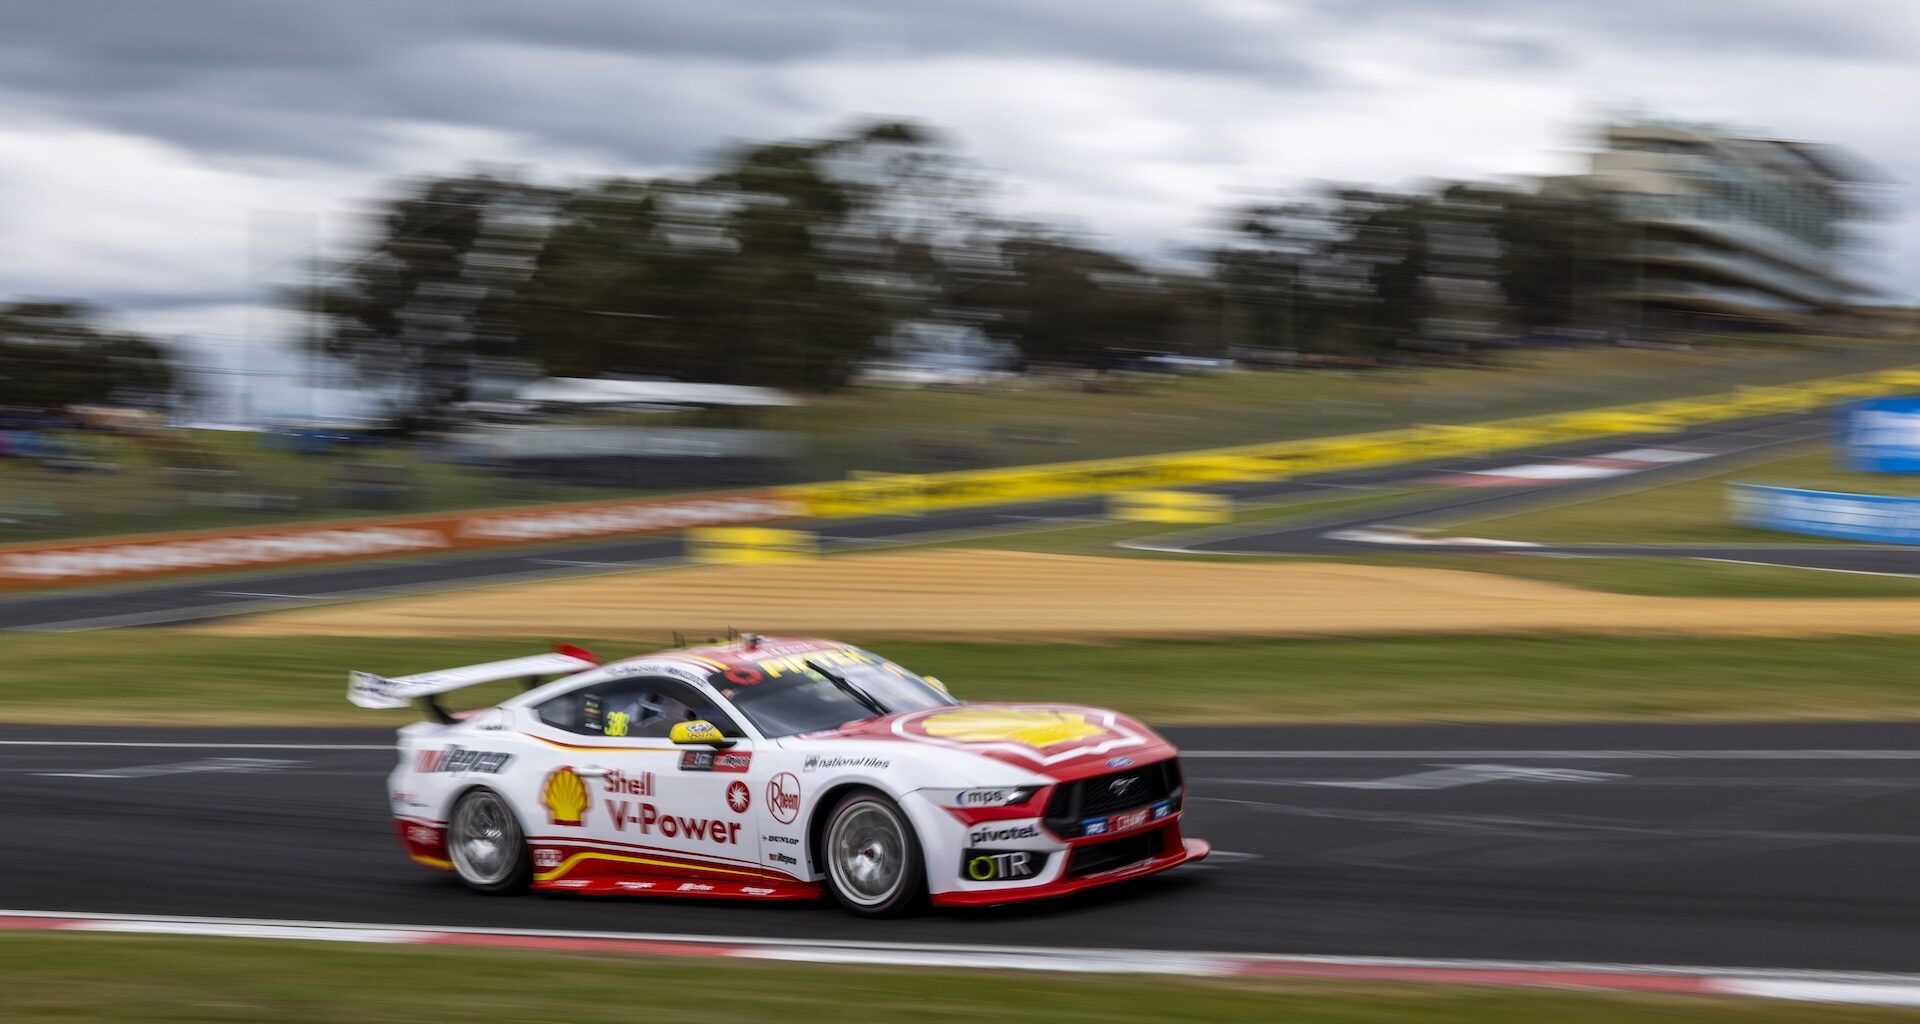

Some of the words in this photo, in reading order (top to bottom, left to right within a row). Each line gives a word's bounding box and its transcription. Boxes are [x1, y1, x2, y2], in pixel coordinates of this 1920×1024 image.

[819, 757, 865, 769] national
[864, 757, 890, 770] tiles
[602, 769, 656, 797] Shell
[770, 773, 799, 816] Rheem
[967, 789, 1003, 805] mps
[604, 799, 742, 845] V-Power
[768, 835, 799, 846] DUNLOP
[777, 852, 797, 866] Repco
[969, 851, 1033, 881] OTR
